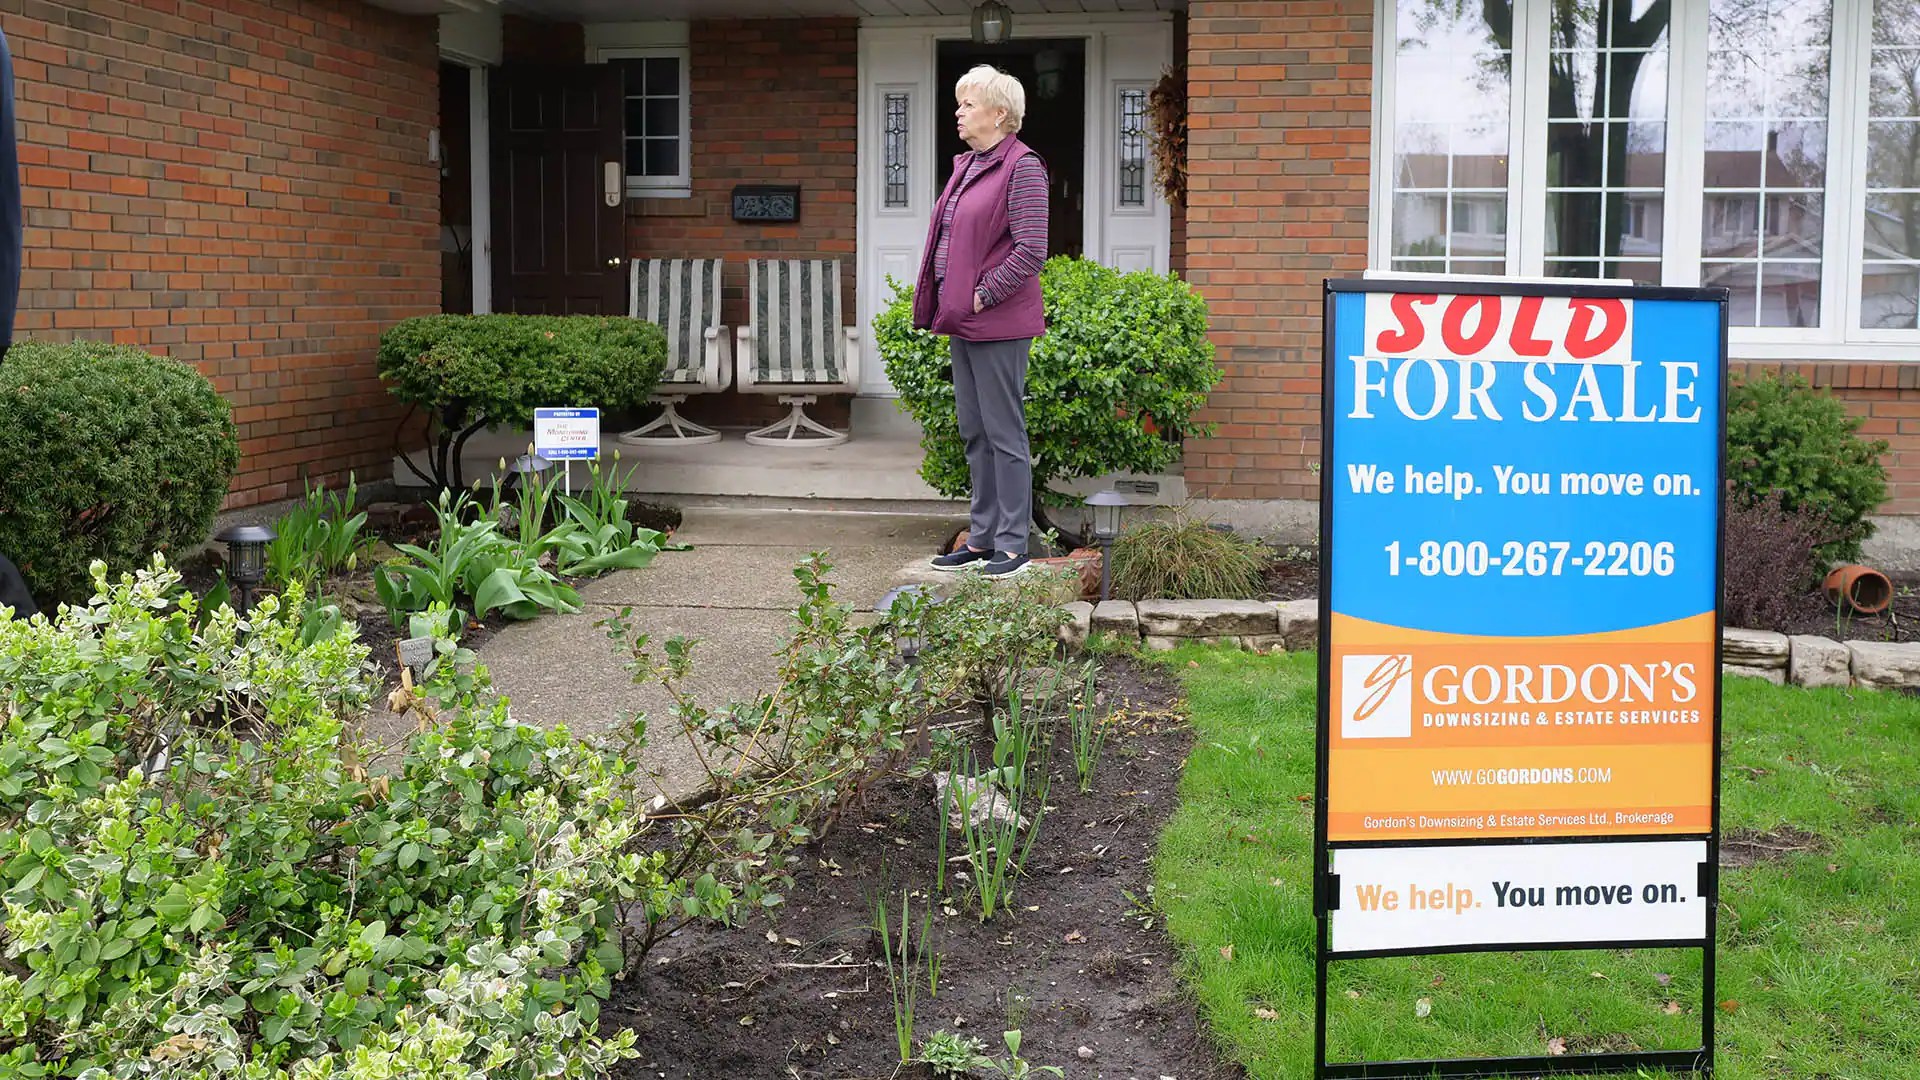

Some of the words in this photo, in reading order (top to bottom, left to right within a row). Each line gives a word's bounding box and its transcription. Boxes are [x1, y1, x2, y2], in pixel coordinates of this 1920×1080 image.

[1376, 293, 1627, 358] SOLD
[1348, 356, 1500, 420] FOR
[1522, 361, 1702, 423] SALE
[1348, 465, 1394, 494] We
[1405, 464, 1482, 500] help.
[1493, 465, 1550, 495] You
[1560, 473, 1643, 496] move
[1653, 473, 1700, 496] on.
[1384, 540, 1675, 576] 1-800-267-2206
[1422, 661, 1697, 706] GORDON'S
[1423, 712, 1530, 727] DOWNSIZING
[1536, 711, 1549, 726] &
[1555, 710, 1614, 726] ESTATE
[1619, 709, 1700, 725] SERVICES
[1432, 767, 1612, 786] WWW.GOGORDONS.COM
[1364, 815, 1416, 829] Gordon's
[1419, 814, 1484, 830] Downsizing
[1486, 814, 1497, 827] &
[1500, 813, 1536, 827] Estate
[1538, 812, 1586, 826] Services
[1589, 812, 1612, 827] Ltd.,
[1615, 810, 1674, 827] Brokerage
[1356, 884, 1398, 911] We
[1409, 882, 1482, 914] help.
[1492, 881, 1545, 907] You
[1555, 882, 1632, 906] move
[1642, 881, 1686, 904] on.
